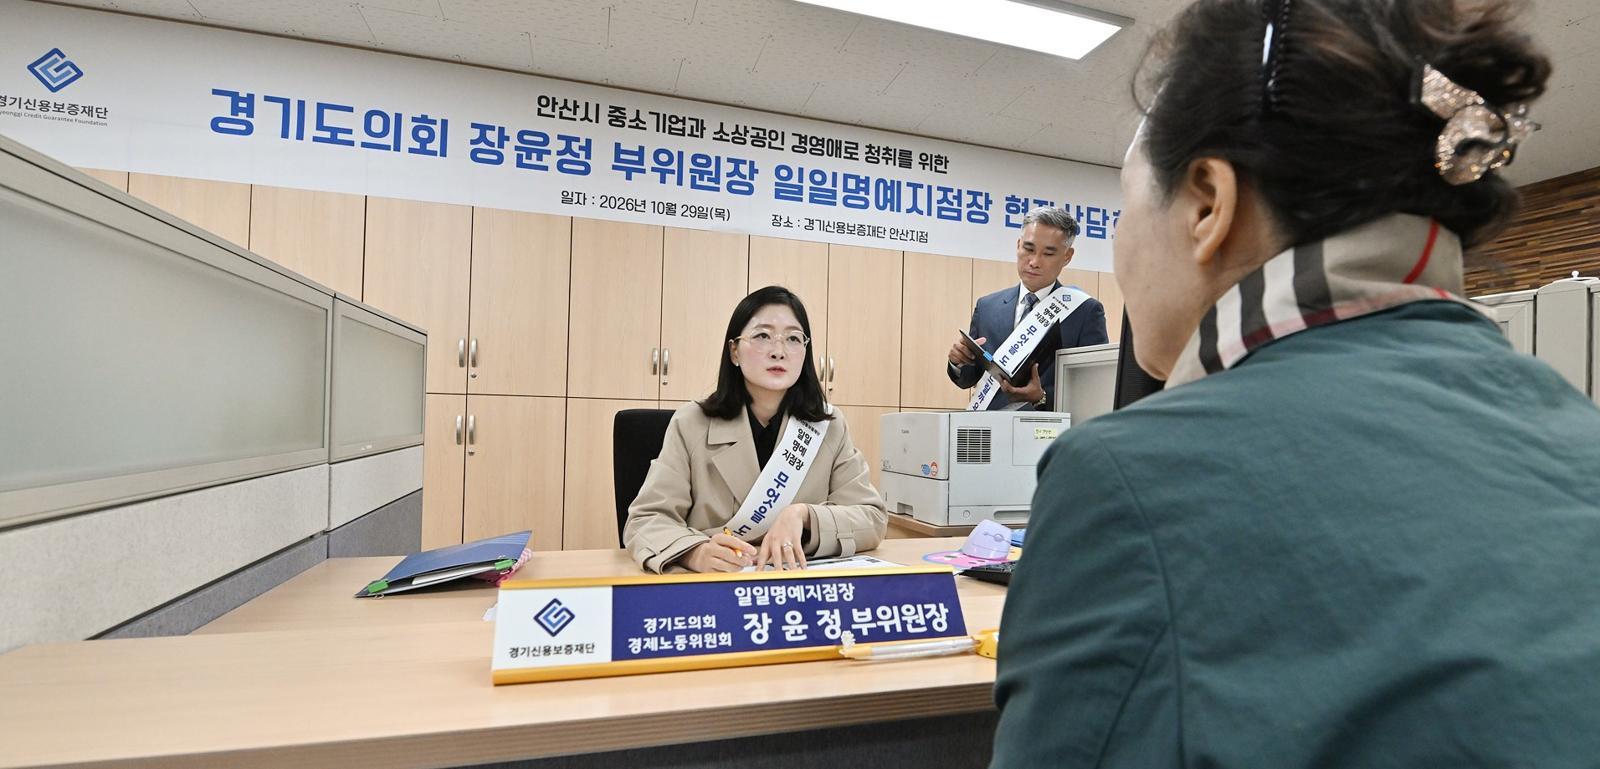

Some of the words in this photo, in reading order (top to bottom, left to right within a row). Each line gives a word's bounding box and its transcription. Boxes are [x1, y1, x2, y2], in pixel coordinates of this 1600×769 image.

[43, 114, 73, 122] Guarantee
[75, 118, 108, 126] Foundation
[536, 94, 600, 124] 안산시
[607, 105, 706, 139] 중소기업과
[712, 122, 785, 152] 소상공인
[791, 132, 859, 162] 경영애로
[864, 142, 914, 170] 청취를
[918, 152, 950, 175] 위한
[210, 88, 448, 158] 경기도의회
[469, 122, 593, 177] 장윤정
[611, 142, 760, 197] 부위원장
[773, 164, 993, 225] 일일명예지점장
[560, 190, 587, 206] 일자
[599, 195, 647, 213] 2026년
[651, 200, 678, 217] 10월
[681, 203, 731, 222] 29일(목)
[771, 214, 794, 229] 장소
[803, 217, 887, 240] 경기신용보증재단
[889, 227, 929, 244] 안산지점
[1043, 307, 1056, 320] 명예
[1049, 302, 1062, 315] 일일
[1035, 312, 1050, 328] 지점장
[1009, 325, 1037, 356] 무엇을
[797, 428, 812, 446] 일일
[792, 440, 807, 457] 명예
[782, 449, 804, 471] 지점장
[750, 471, 790, 524] 무엇을
[734, 582, 855, 607] 일일명예지점장
[643, 614, 717, 634] 경기도의회
[851, 602, 950, 636] 부위원장
[508, 642, 596, 659] 경기신용보증재단
[627, 632, 733, 654] 경제노동위원회
